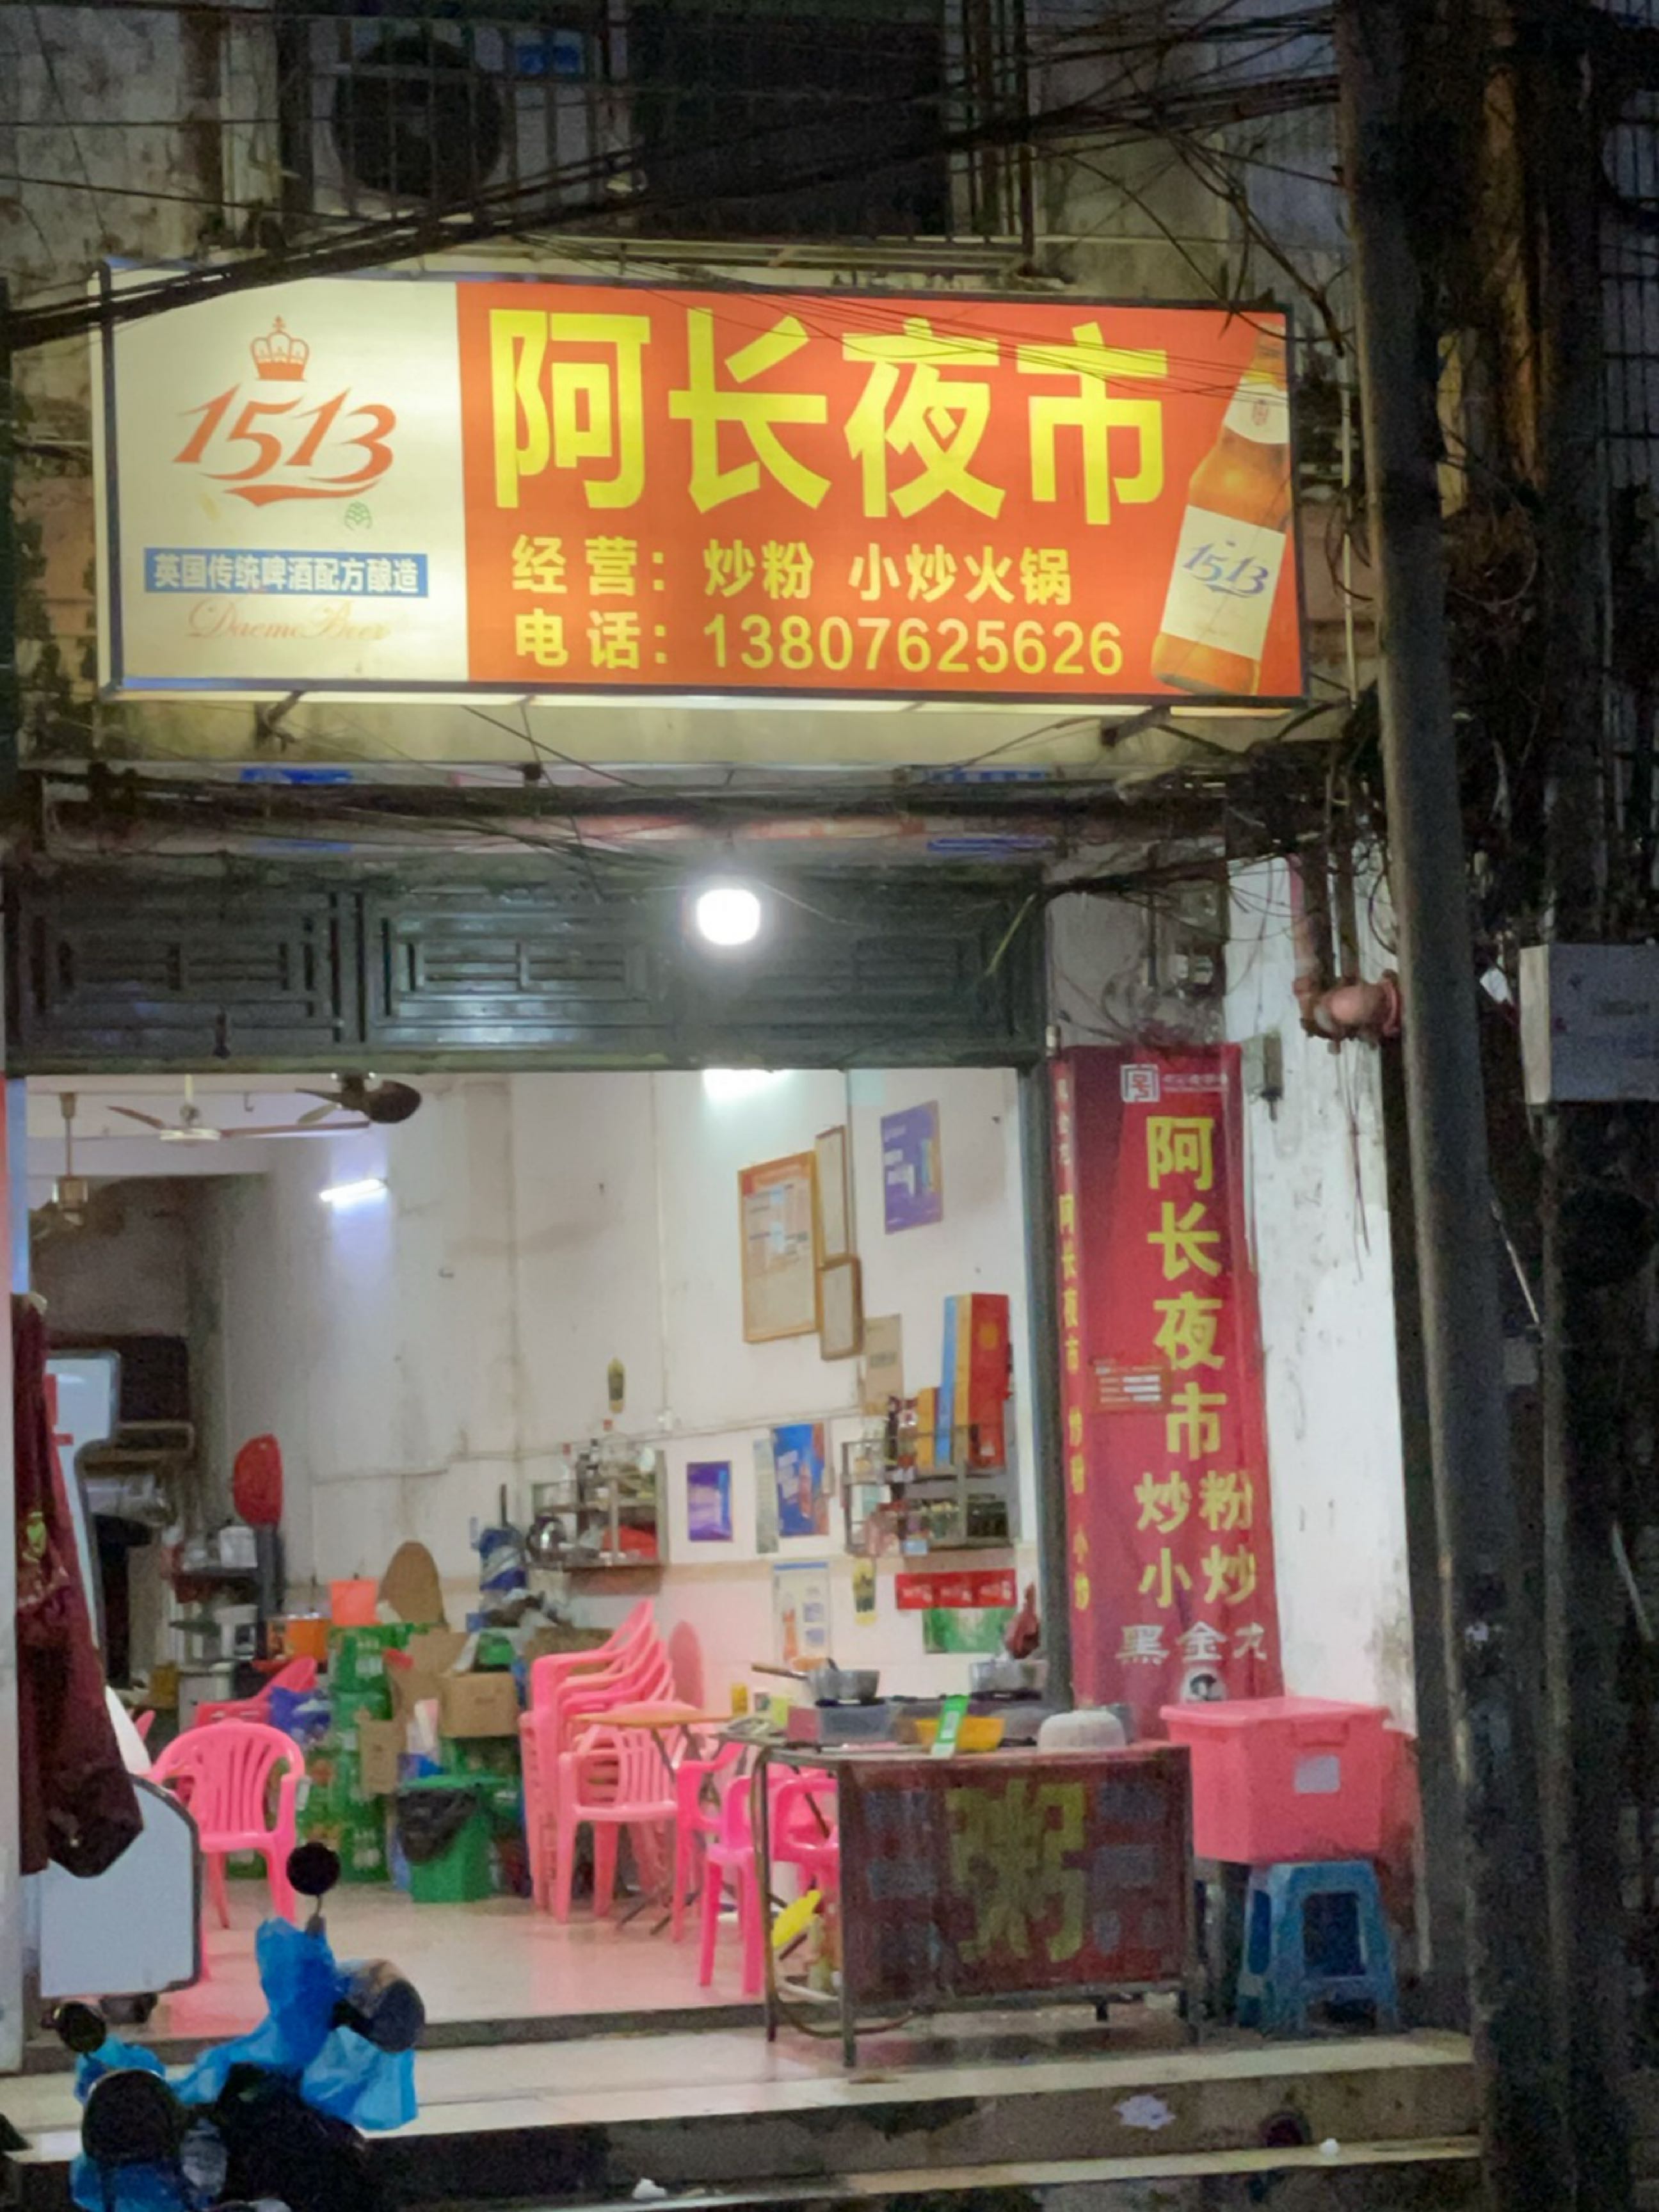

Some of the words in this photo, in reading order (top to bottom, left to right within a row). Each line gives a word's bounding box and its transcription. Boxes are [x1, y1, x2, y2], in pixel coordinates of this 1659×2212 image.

[172, 384, 396, 485] 1513
[490, 308, 1167, 525] 阿长夜市
[154, 553, 418, 593] 英国传统啤酒配方酿造
[703, 538, 813, 599] 炒粉
[848, 543, 1071, 605] 小炒火锅
[1182, 543, 1269, 595] 1513
[703, 613, 1122, 675] 13807625626
[1146, 1116, 1227, 1460] 阿长夜市
[1133, 1470, 1253, 1534] 炒粉
[1138, 1544, 1257, 1608] 小炒
